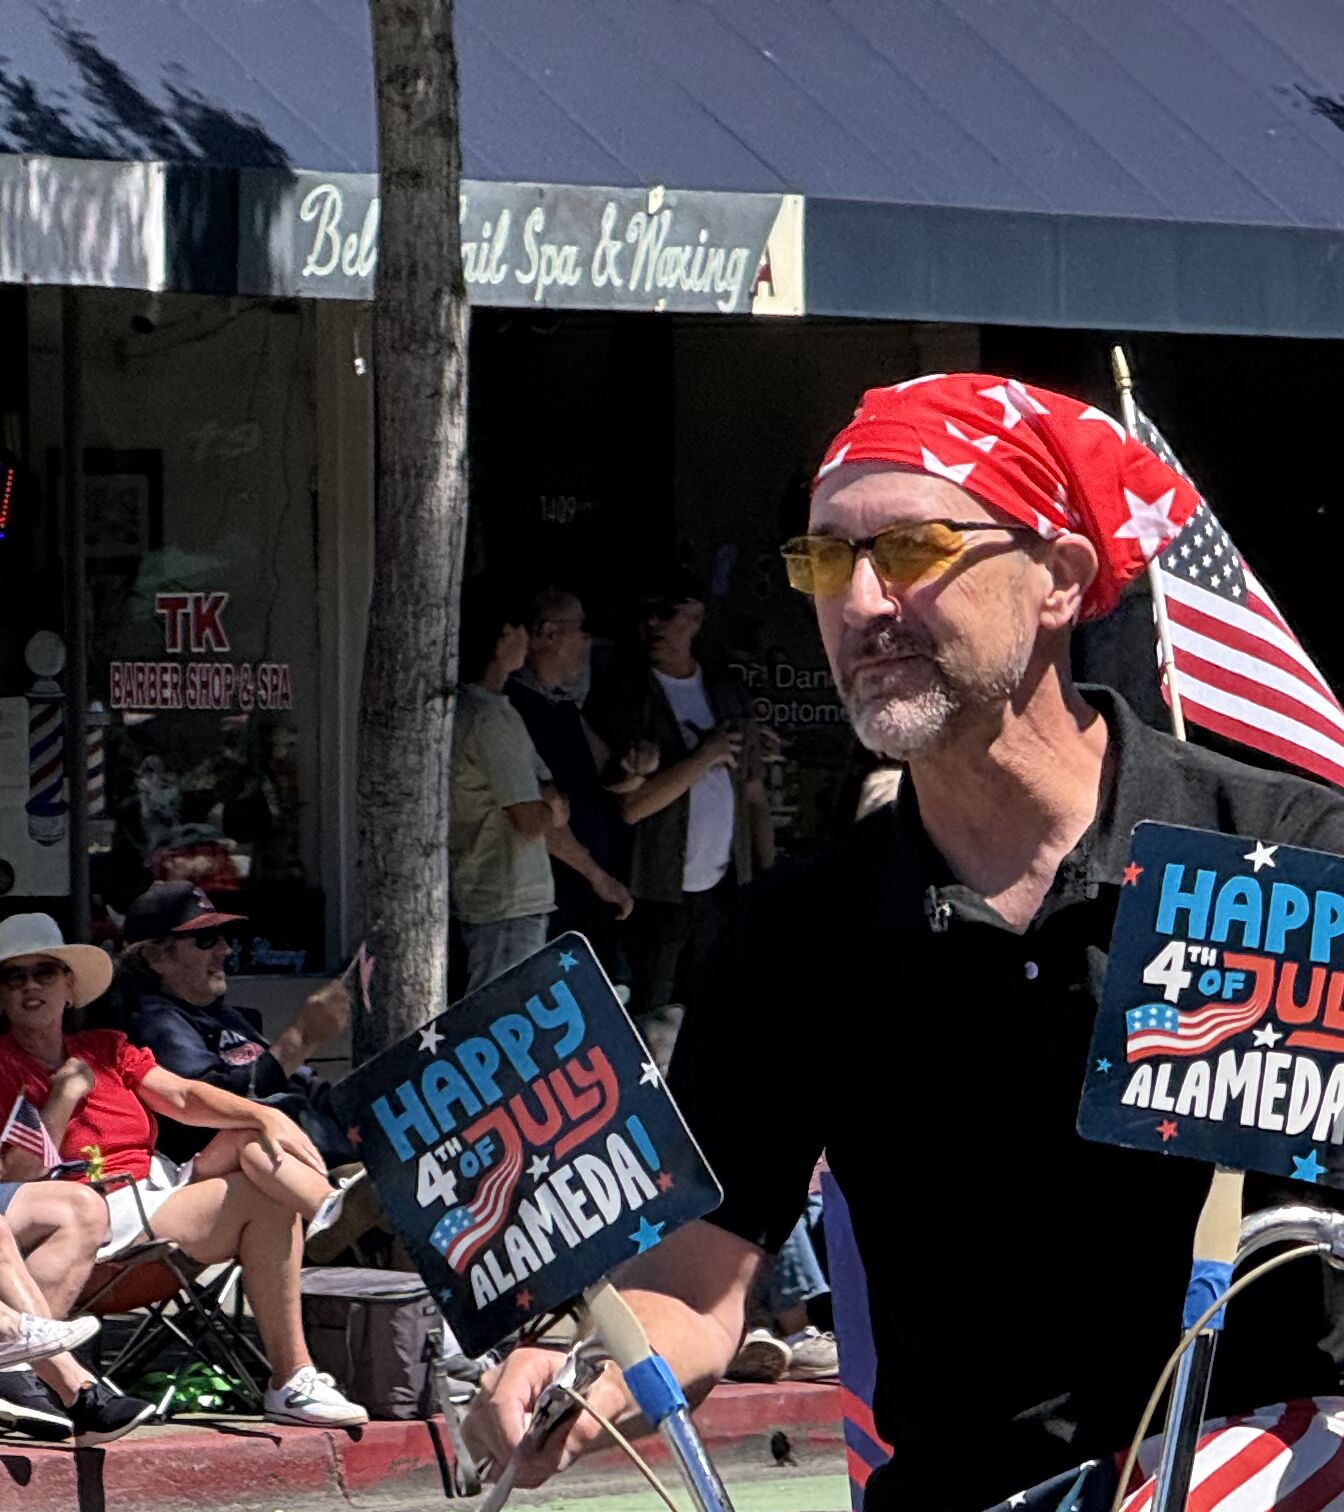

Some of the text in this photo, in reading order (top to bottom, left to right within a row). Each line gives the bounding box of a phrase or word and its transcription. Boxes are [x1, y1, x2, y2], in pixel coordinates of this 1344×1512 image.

[300, 184, 751, 312] Bel ail Spa & Waxing
[155, 591, 231, 653] TK
[109, 661, 293, 711] BARBER SHOP & SPA
[776, 663, 830, 689] Dan
[1142, 940, 1218, 1003] 4TH
[1197, 969, 1247, 1000] OF
[370, 979, 587, 1163] HAPPY
[413, 1046, 620, 1208] 4TH OF JULY
[469, 1113, 661, 1311] ALAMEDA!
